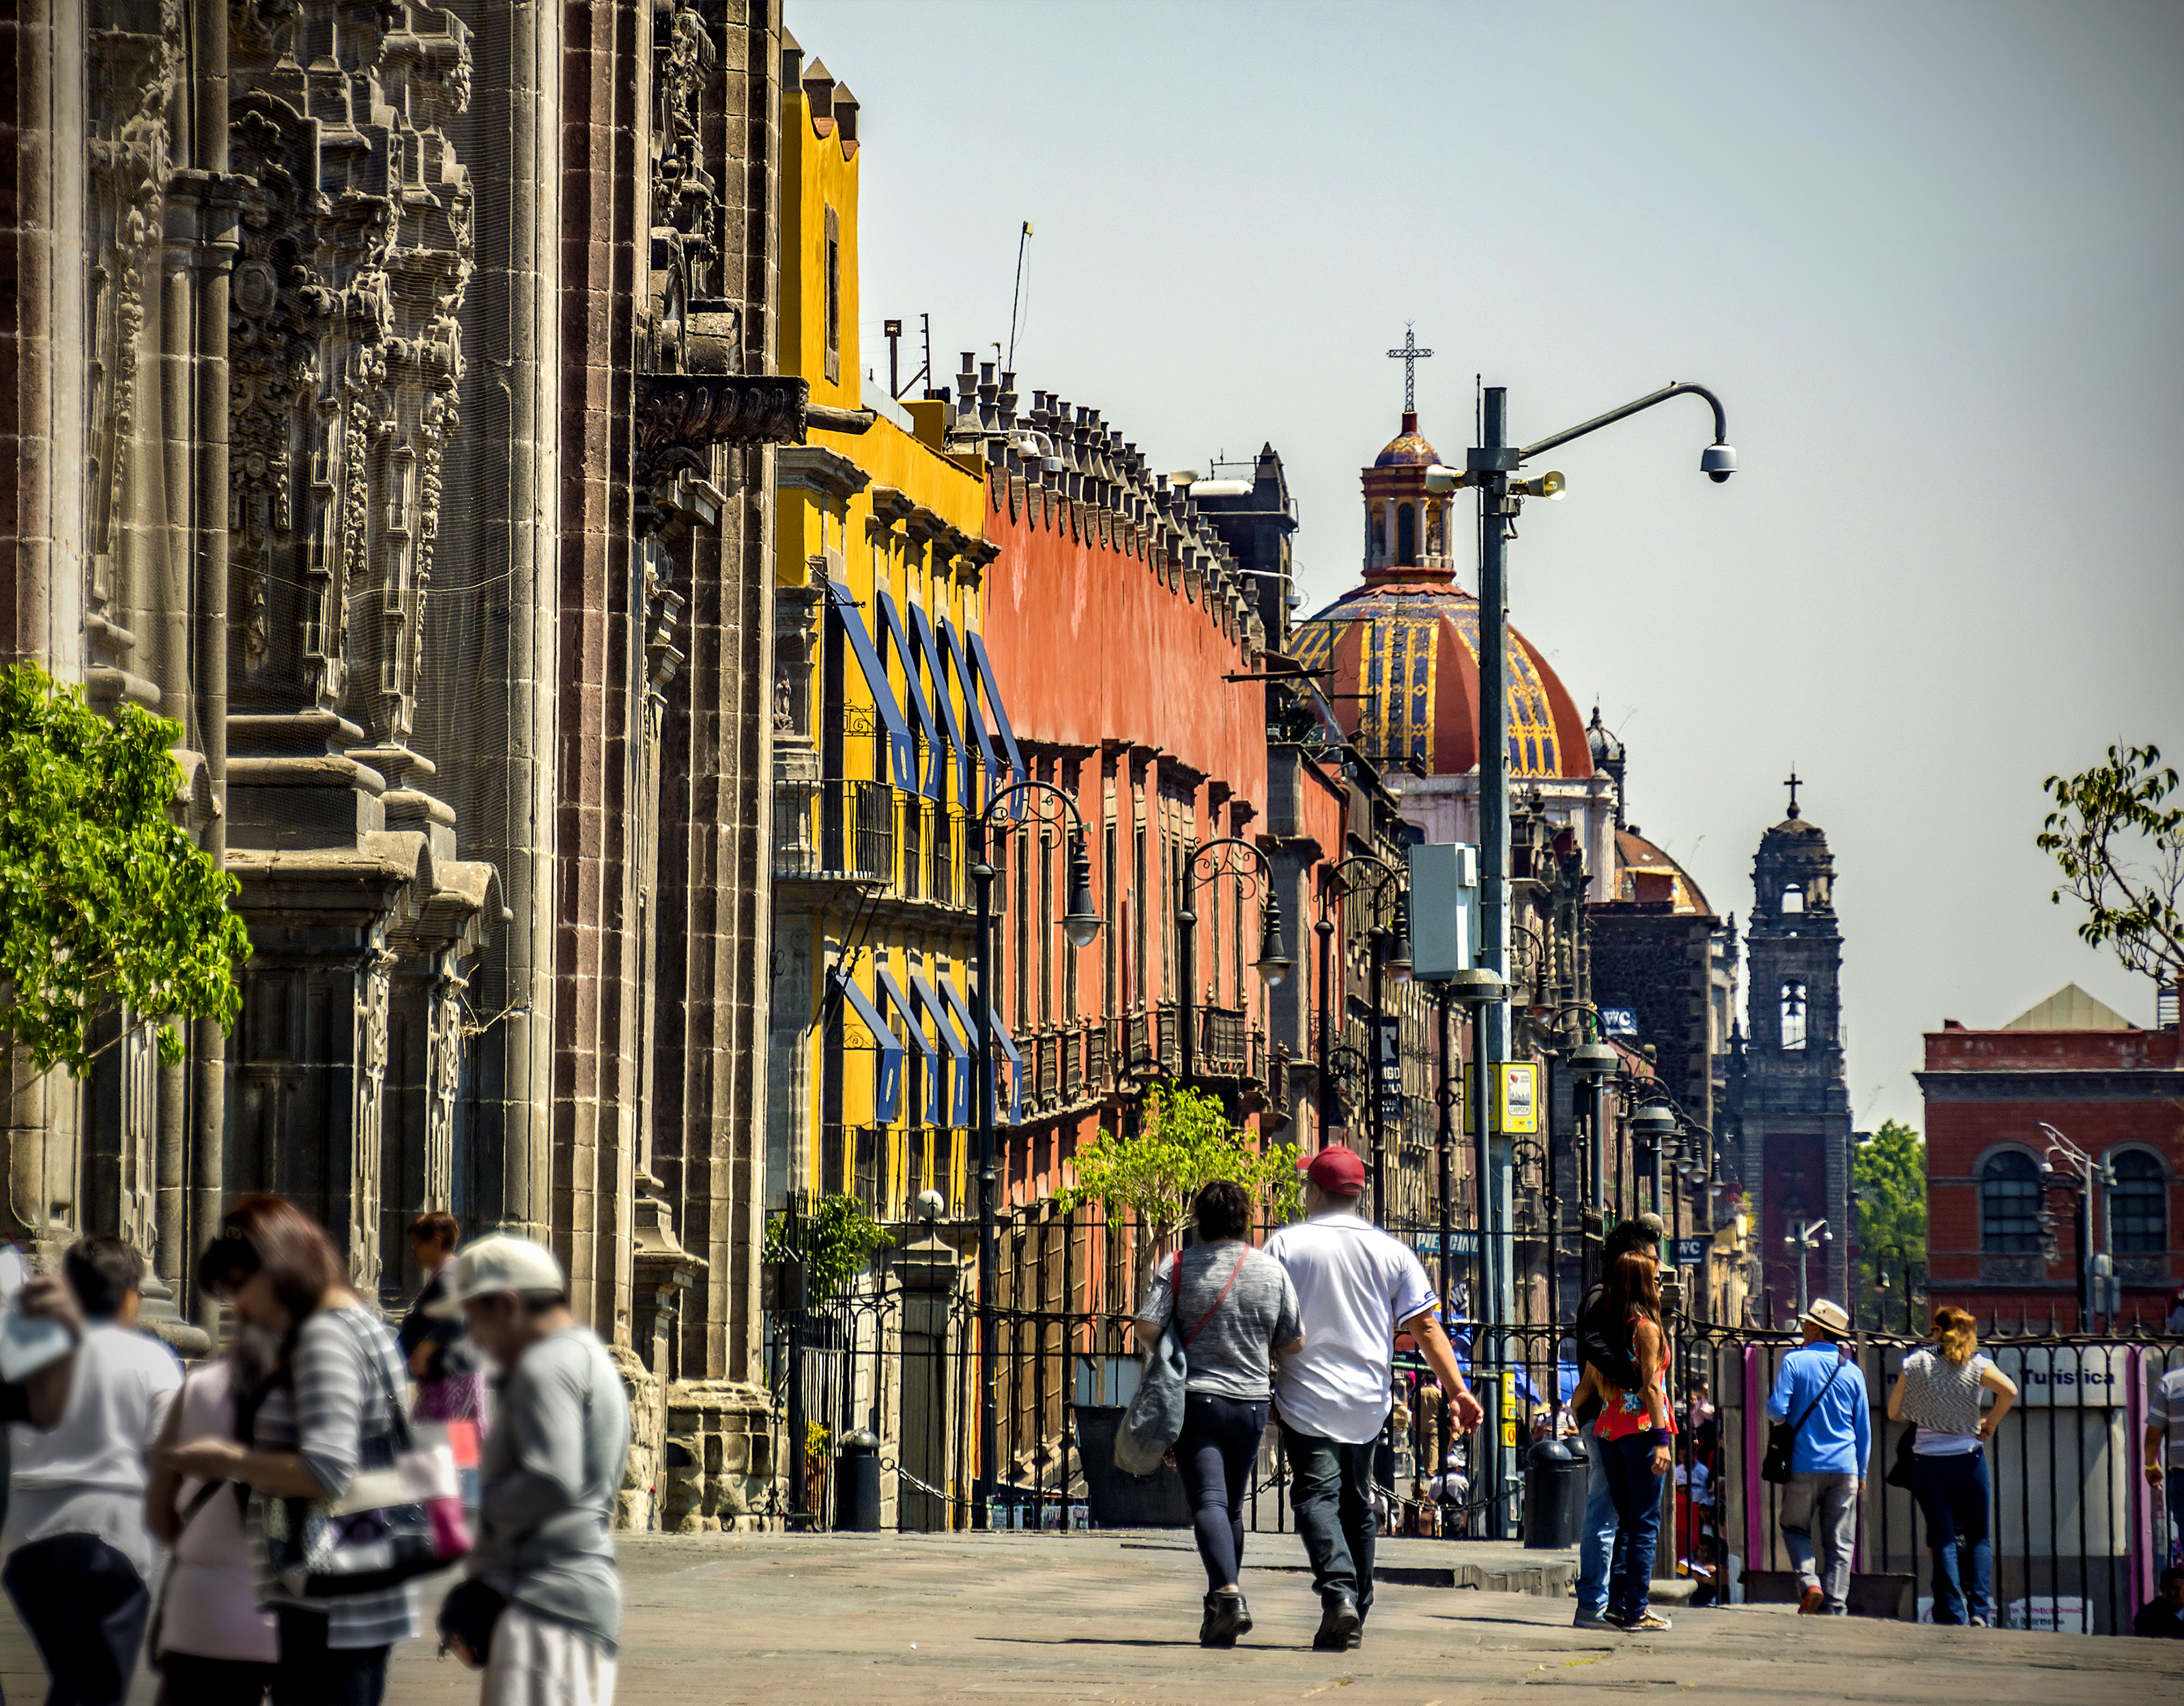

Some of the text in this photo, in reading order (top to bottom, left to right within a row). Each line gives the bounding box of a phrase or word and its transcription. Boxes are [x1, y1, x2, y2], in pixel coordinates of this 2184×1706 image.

[1603, 1011, 1631, 1026] WC
[1416, 1232, 1479, 1252] PIECING
[1679, 1241, 1701, 1255] WC
[1451, 1283, 1468, 1305] WC
[2020, 1368, 2114, 1385] Tuísica
